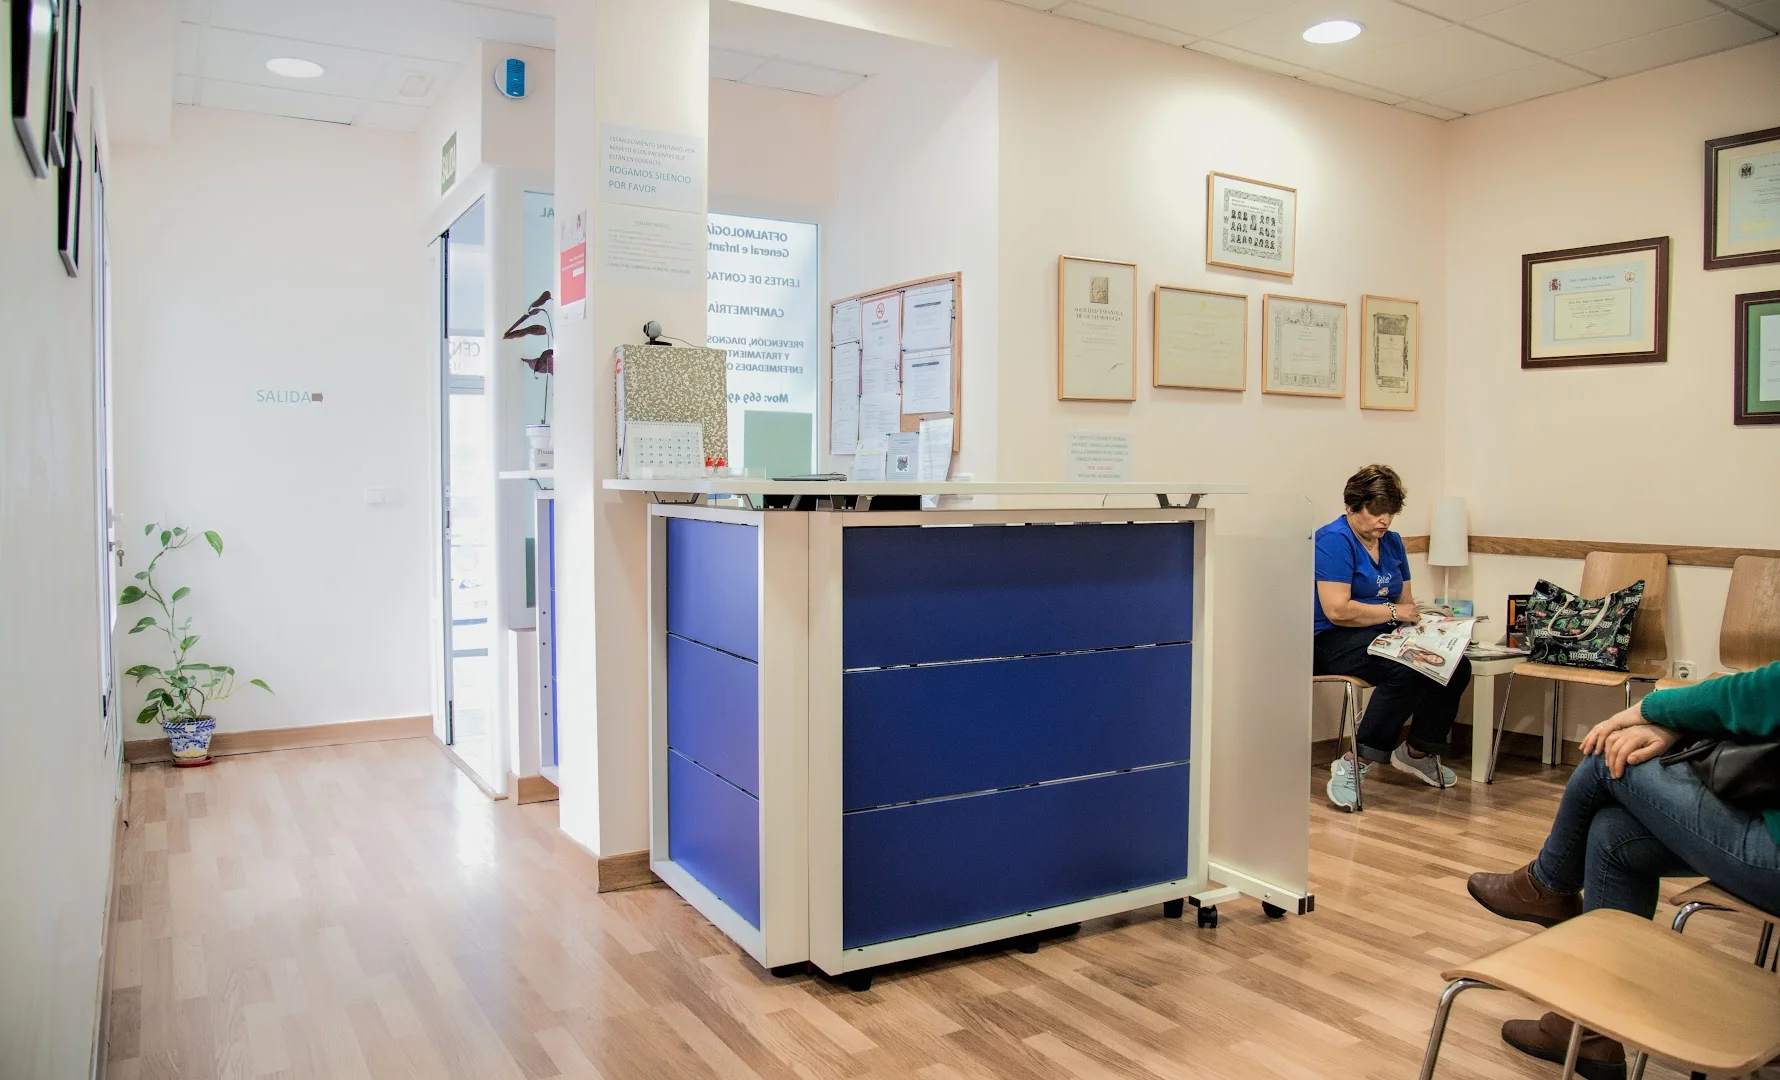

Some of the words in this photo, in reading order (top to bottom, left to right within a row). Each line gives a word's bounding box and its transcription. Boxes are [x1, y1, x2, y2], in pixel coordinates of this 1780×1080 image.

[609, 135, 655, 147] ESTABLECIMIENTO
[609, 144, 632, 154] RESPETO
[648, 150, 674, 160] PACIENTES
[609, 165, 653, 179] ROGAMOS
[655, 172, 692, 184] SILENCIO
[608, 180, 626, 189] POR
[628, 182, 657, 194] FAVOR
[256, 389, 312, 404] SALIDA
